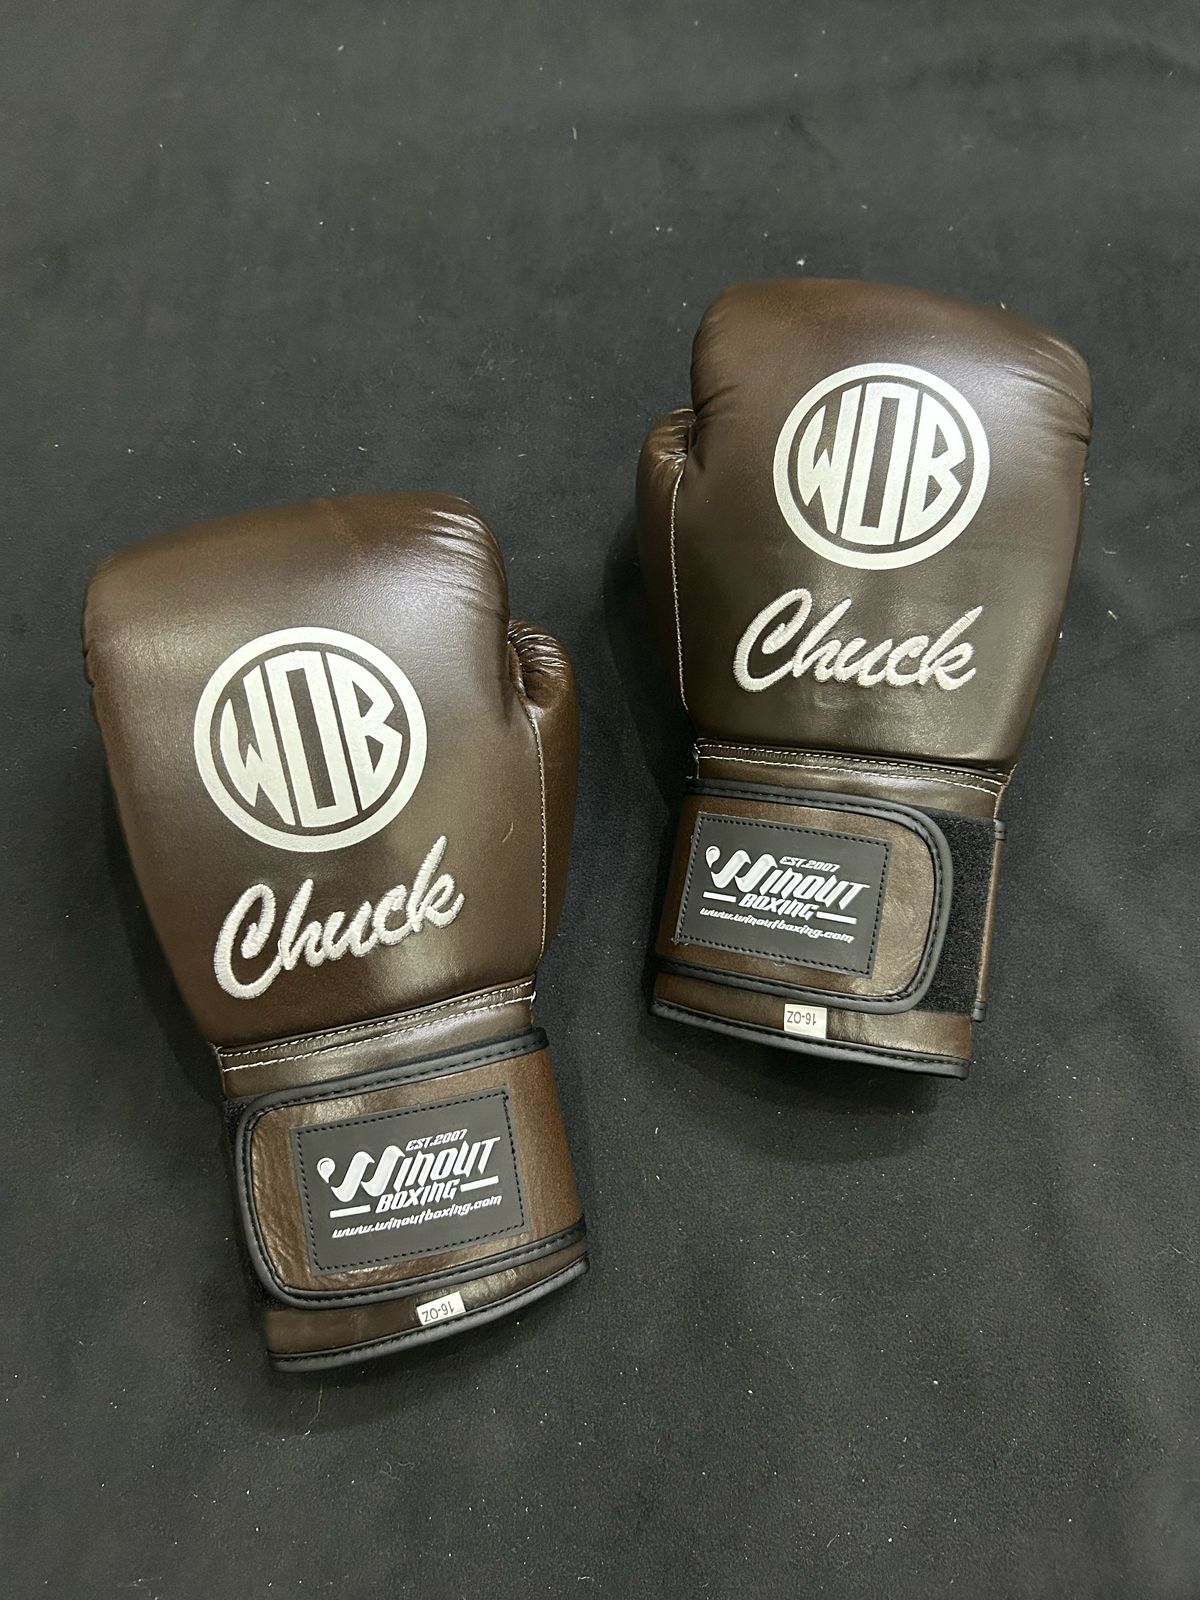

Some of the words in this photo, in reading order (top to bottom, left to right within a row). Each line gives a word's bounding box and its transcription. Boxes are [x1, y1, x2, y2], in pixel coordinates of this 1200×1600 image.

[732, 588, 983, 693] Chuck
[779, 855, 840, 873] EST.2007
[213, 835, 465, 1000] Chuck
[699, 907, 855, 944] www.winoutboxing.com
[786, 1011, 816, 1026] 16-OZ
[405, 1128, 468, 1151] EST.2007
[332, 1195, 502, 1239] www.winoutboxing.com
[421, 1300, 455, 1323] 16-OZ
